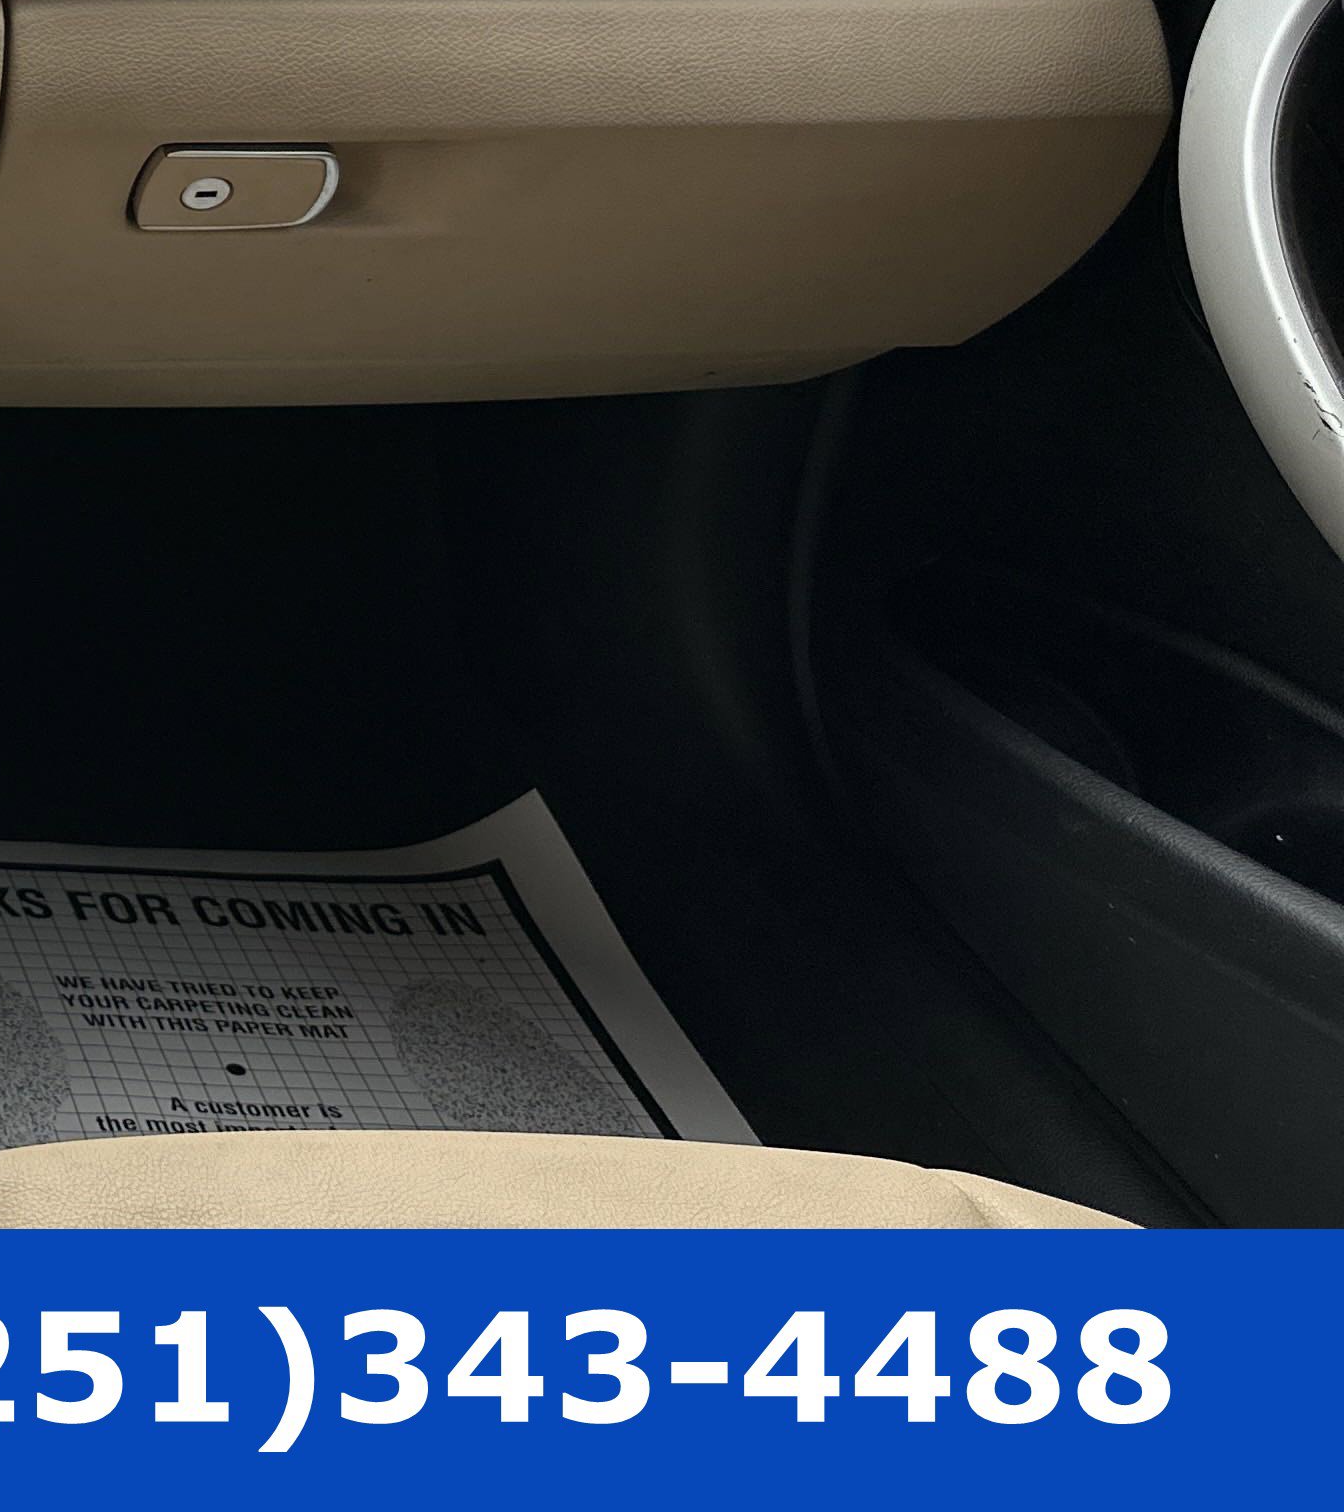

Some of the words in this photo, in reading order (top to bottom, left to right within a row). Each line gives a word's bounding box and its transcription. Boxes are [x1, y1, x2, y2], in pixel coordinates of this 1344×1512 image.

[70, 890, 180, 928] FOR
[191, 895, 413, 937] COMING
[421, 902, 488, 938] IN
[55, 974, 92, 989] WE
[101, 976, 161, 993] HAVE
[164, 980, 236, 997] TRIED
[242, 984, 274, 999] TO
[281, 986, 339, 1000] KEEP
[61, 993, 130, 1010] YOUR
[137, 996, 269, 1018] CARPETING
[276, 1003, 354, 1020] CLEAN
[82, 1013, 147, 1028] WITH
[153, 1016, 208, 1033] THIS
[216, 1019, 293, 1038] PAPER
[300, 1023, 349, 1039] MAT
[170, 1096, 188, 1113] A
[194, 1099, 310, 1119] customer
[319, 1104, 343, 1119] is
[96, 1115, 137, 1132] the
[145, 1118, 207, 1134] most
